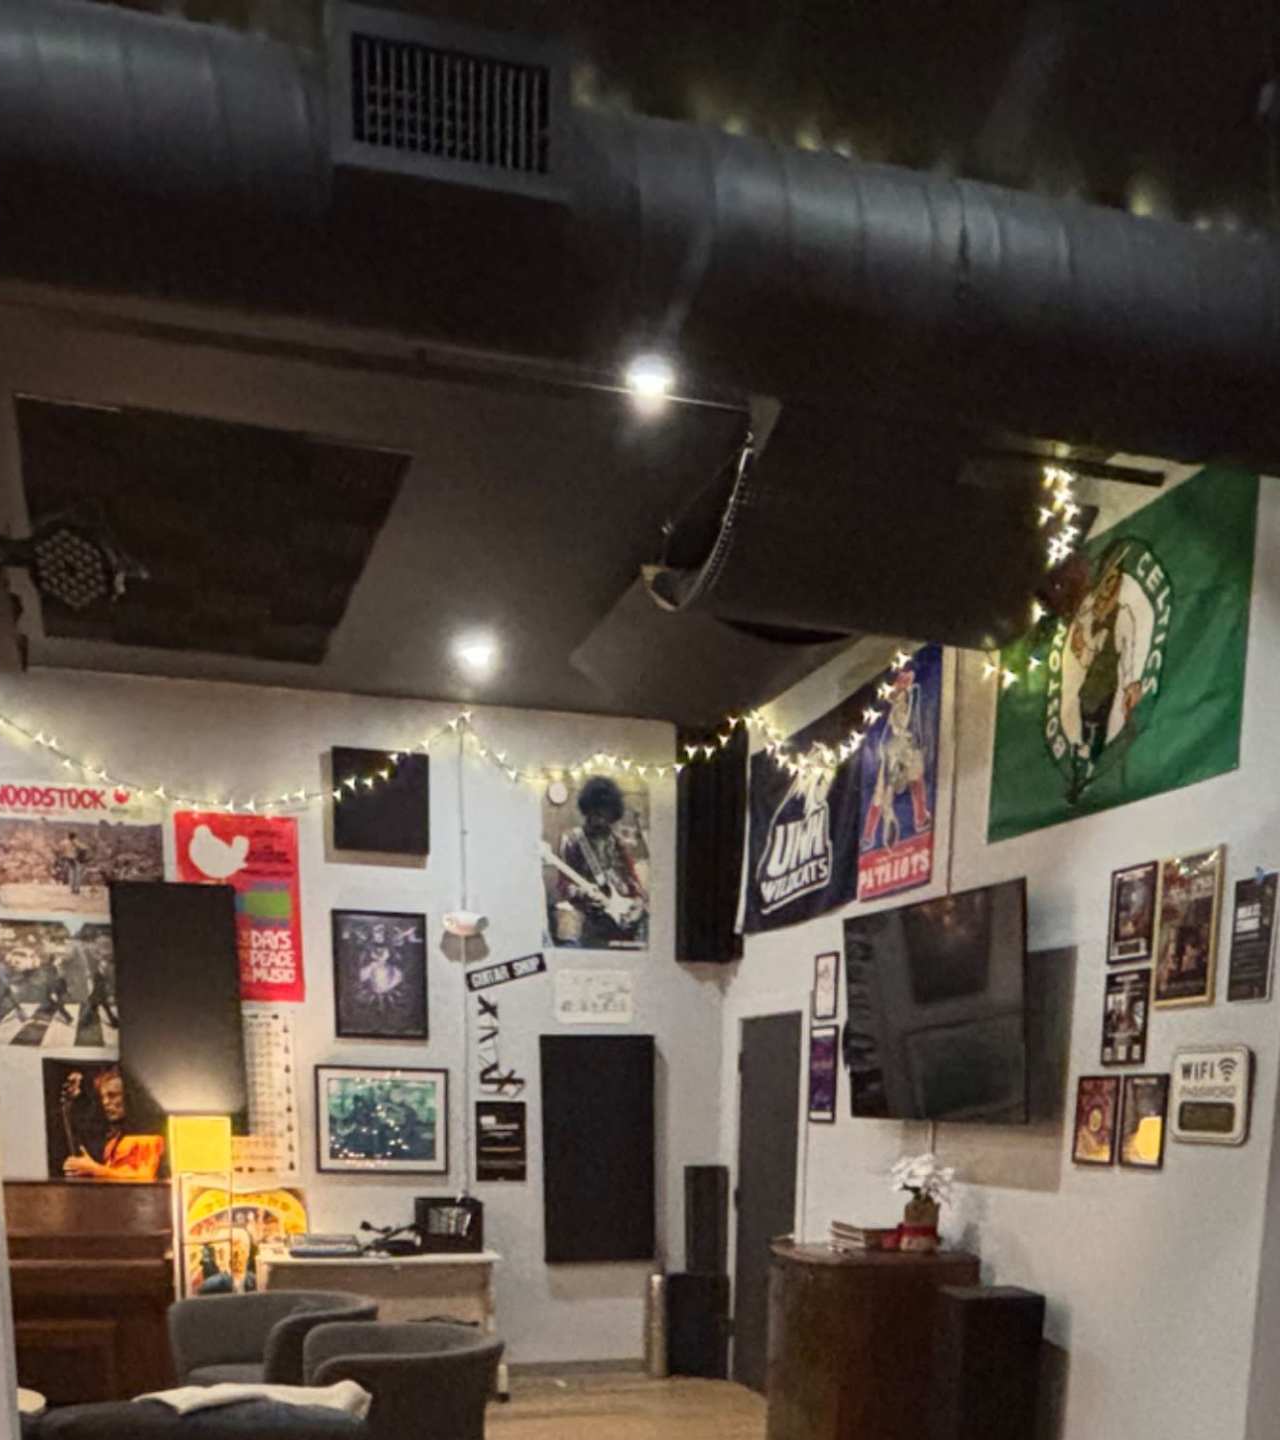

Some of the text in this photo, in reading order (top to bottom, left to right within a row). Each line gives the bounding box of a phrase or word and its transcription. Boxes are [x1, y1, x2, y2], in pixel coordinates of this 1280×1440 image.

[1136, 551, 1171, 695] CELTICS
[858, 847, 929, 889] PATRIOTS
[251, 930, 292, 951] DAYS
[251, 950, 296, 968] PEACE
[253, 967, 297, 985] MUSIC
[1181, 1061, 1215, 1081] WIFI
